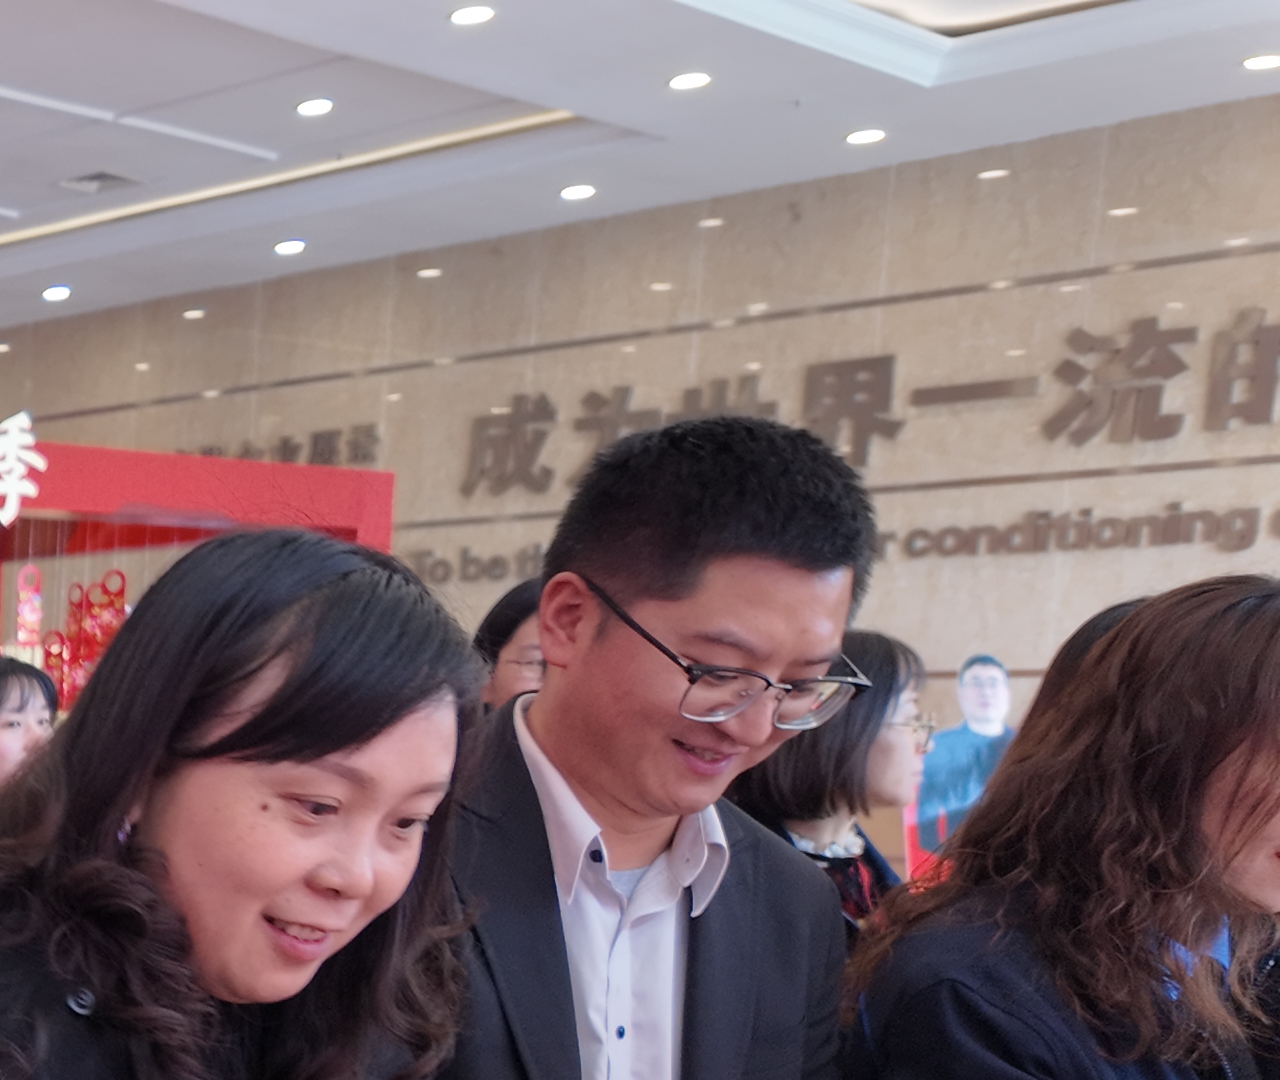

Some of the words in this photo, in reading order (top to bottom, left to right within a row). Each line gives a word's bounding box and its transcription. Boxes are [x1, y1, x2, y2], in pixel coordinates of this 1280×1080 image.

[411, 549, 453, 584] To
[460, 546, 509, 582] be
[903, 502, 1261, 559] conditioning
